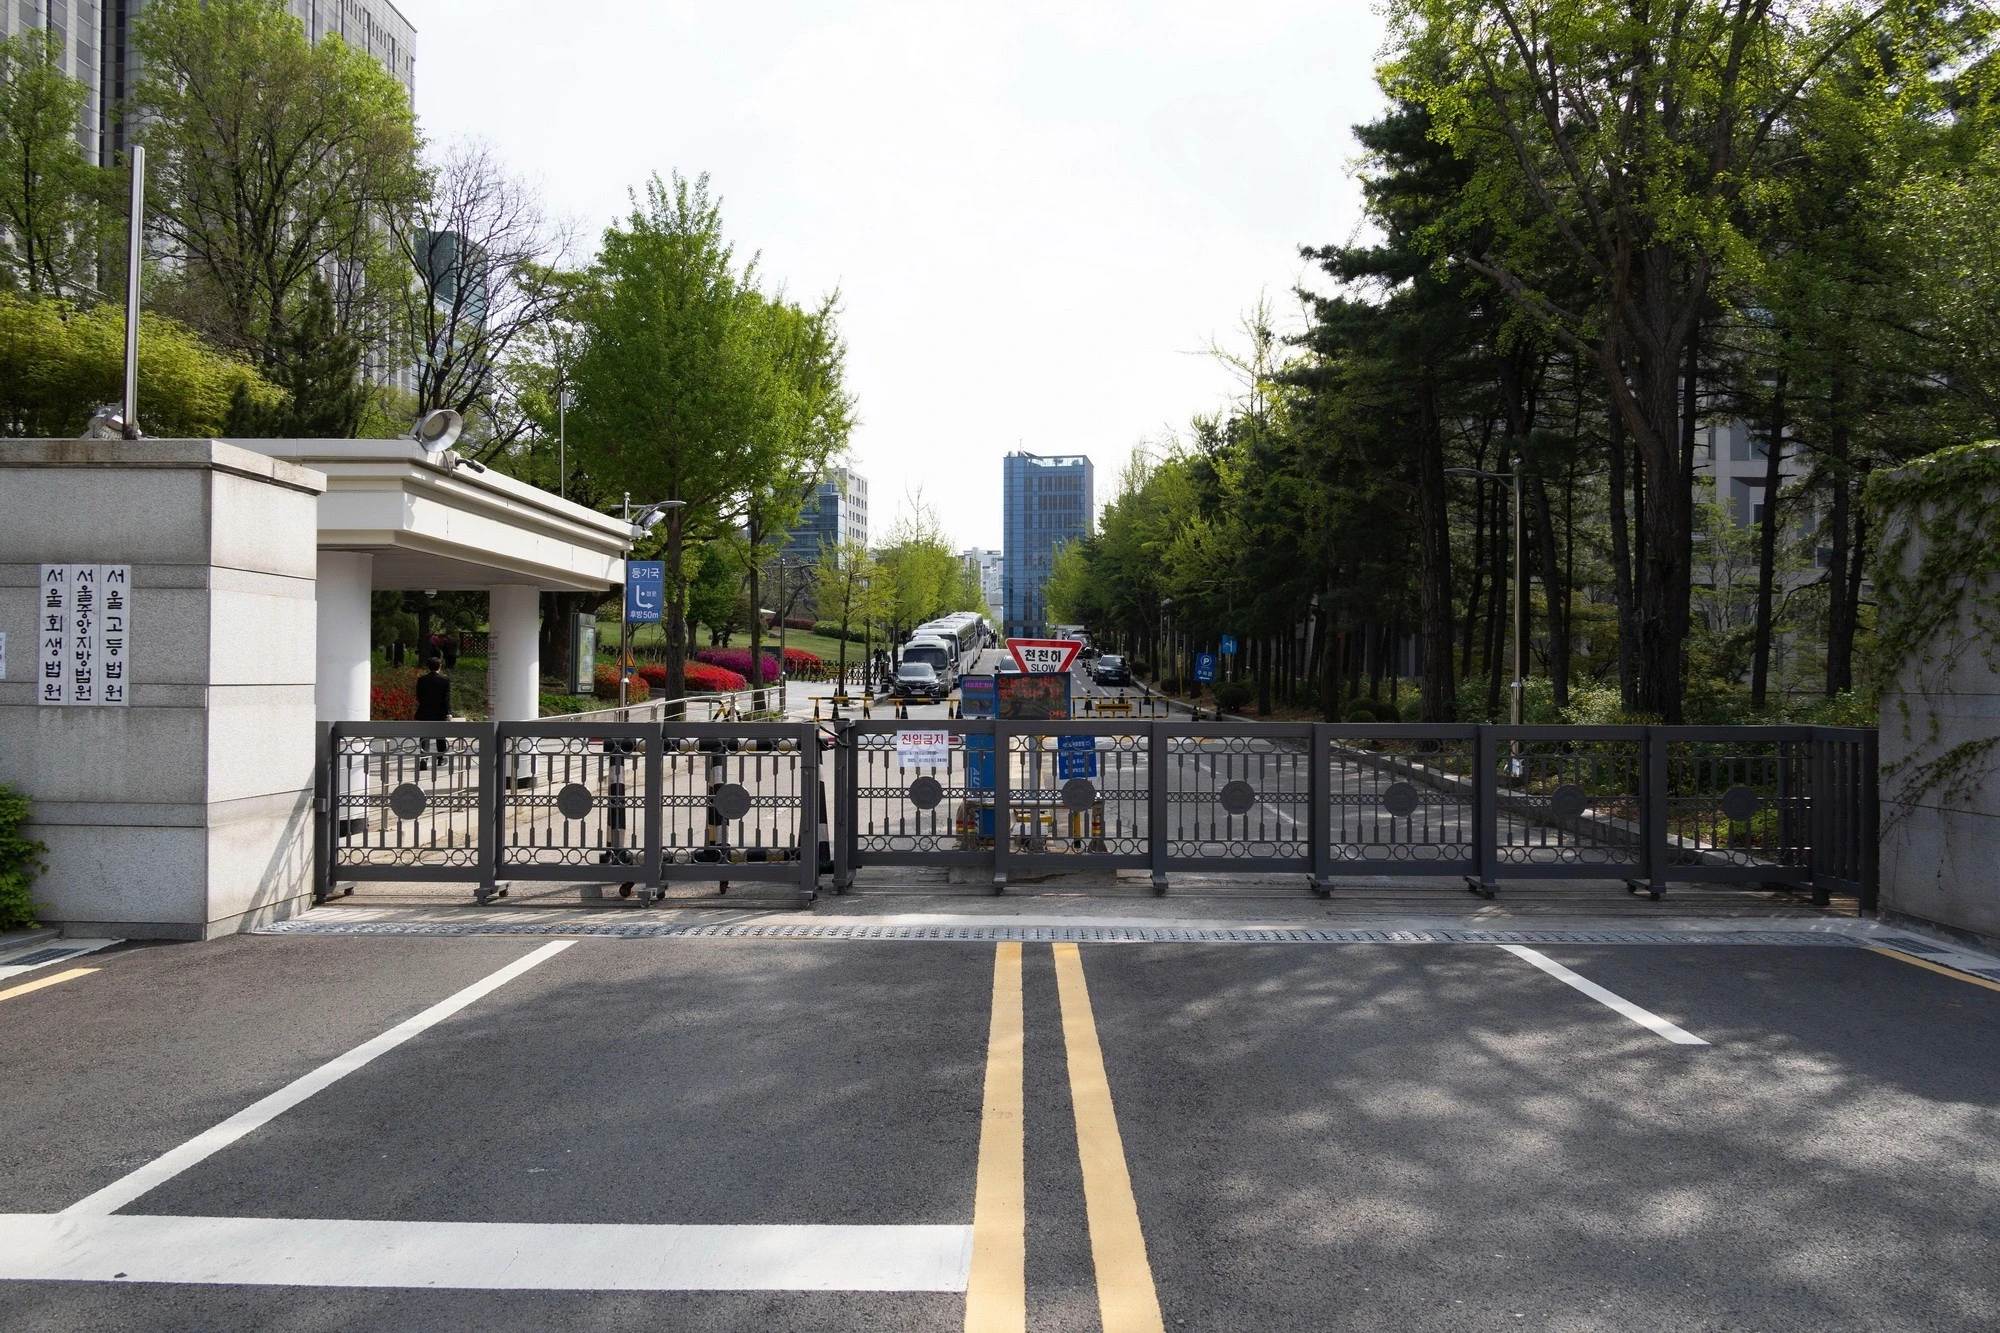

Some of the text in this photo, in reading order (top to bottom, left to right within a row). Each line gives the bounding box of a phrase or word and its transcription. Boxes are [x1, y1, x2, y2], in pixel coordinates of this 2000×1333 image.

[632, 567, 660, 579] 등기국
[44, 568, 64, 702] 서울회생법원
[75, 569, 94, 702] 서울중앙지방법원
[105, 569, 124, 702] 서울고등법원
[1025, 649, 1061, 663] 천천히
[1031, 663, 1056, 672] SLOW
[901, 733, 944, 745] 진입금지
